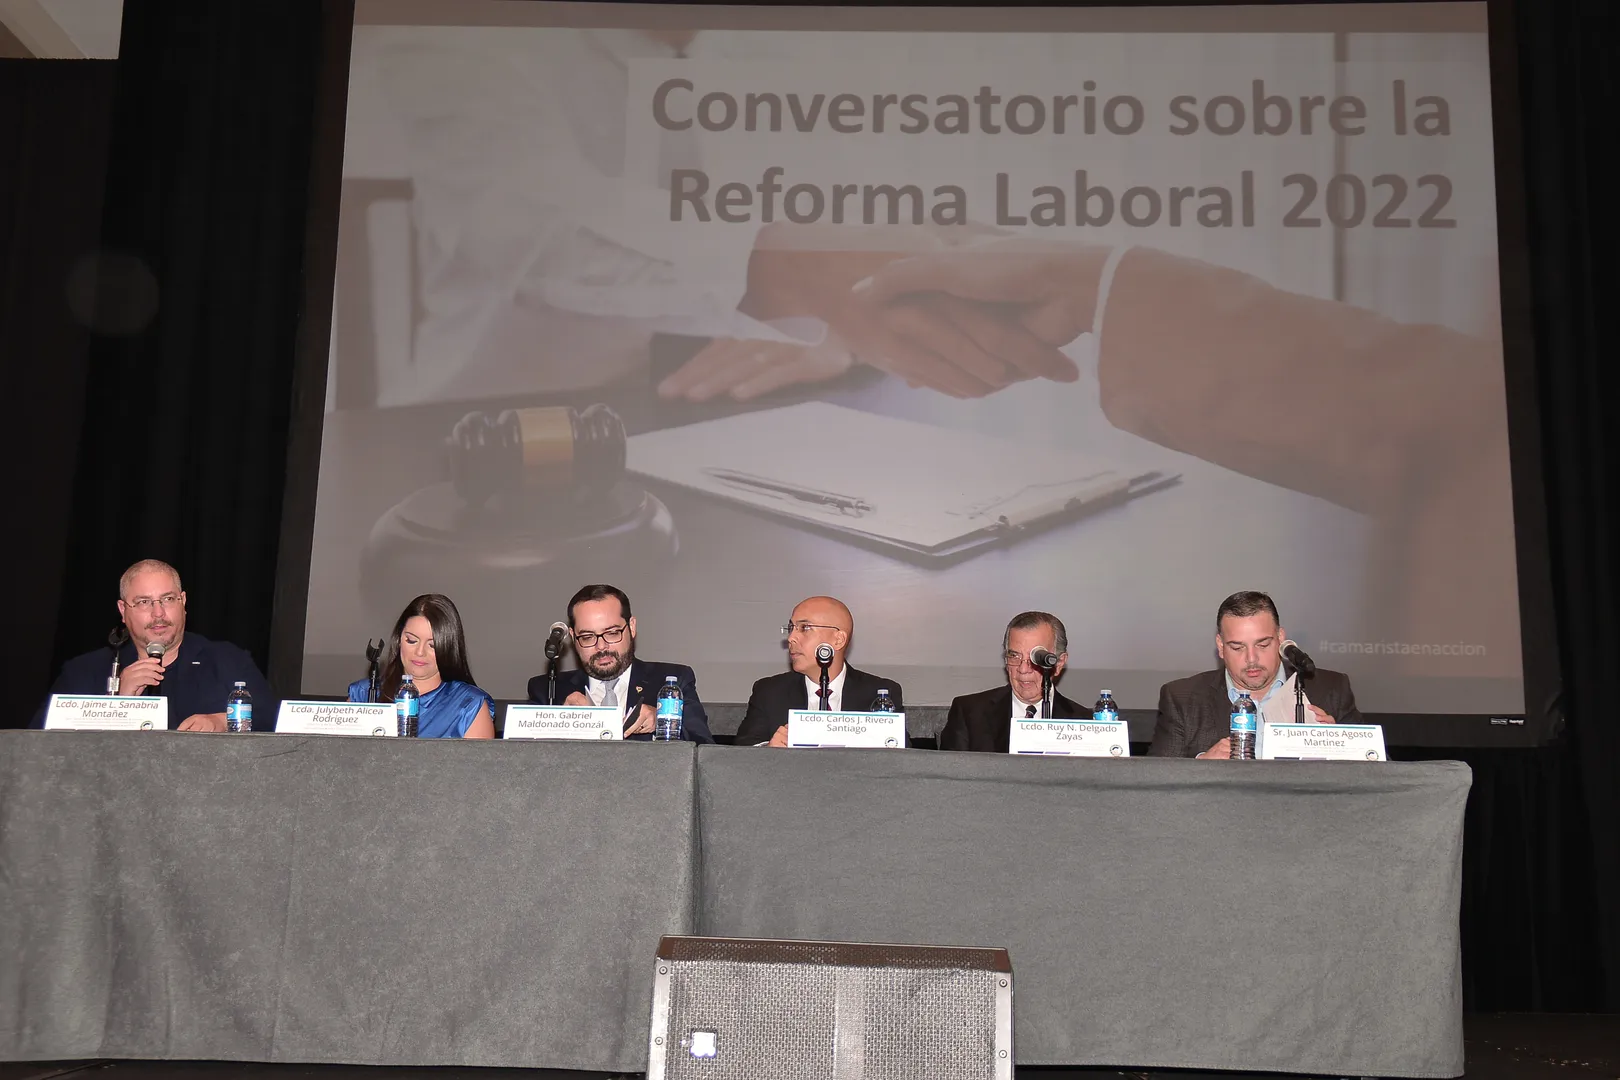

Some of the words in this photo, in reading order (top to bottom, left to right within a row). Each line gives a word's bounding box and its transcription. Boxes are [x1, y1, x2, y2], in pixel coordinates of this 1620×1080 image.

[652, 78, 1144, 135] Conversatorio
[1168, 79, 1367, 136] sobre
[1392, 79, 1451, 136] la
[669, 166, 968, 227] Reforma
[996, 169, 1254, 228] Laboral
[1281, 173, 1458, 229] 2022
[1319, 640, 1487, 657] #camaristaenaccion
[55, 700, 80, 709] Lcdo.
[80, 700, 107, 710] Jaime
[109, 701, 117, 709] L.
[118, 701, 159, 710] Sanabria
[291, 705, 314, 714] Lcda.
[316, 706, 354, 716] Julybeth
[356, 706, 384, 715] Alicea
[82, 709, 128, 718] Montañez
[535, 711, 557, 719] Hon.
[559, 711, 593, 720] Gabriel
[518, 720, 571, 729] Maldonado
[800, 714, 824, 723] Lcdo.
[826, 715, 855, 723] Carlos
[856, 715, 863, 725] J.
[865, 716, 894, 724] Rivera
[826, 724, 867, 734] Santiago
[1020, 723, 1045, 731] Lcdo.
[1047, 723, 1065, 732] Ruy
[1079, 724, 1117, 734] Delgado
[1273, 728, 1285, 736] Sr.
[1287, 728, 1308, 738] Juan
[1310, 729, 1339, 738] Carlos
[1341, 729, 1374, 740] Agosto
[1056, 732, 1083, 742] Zayas
